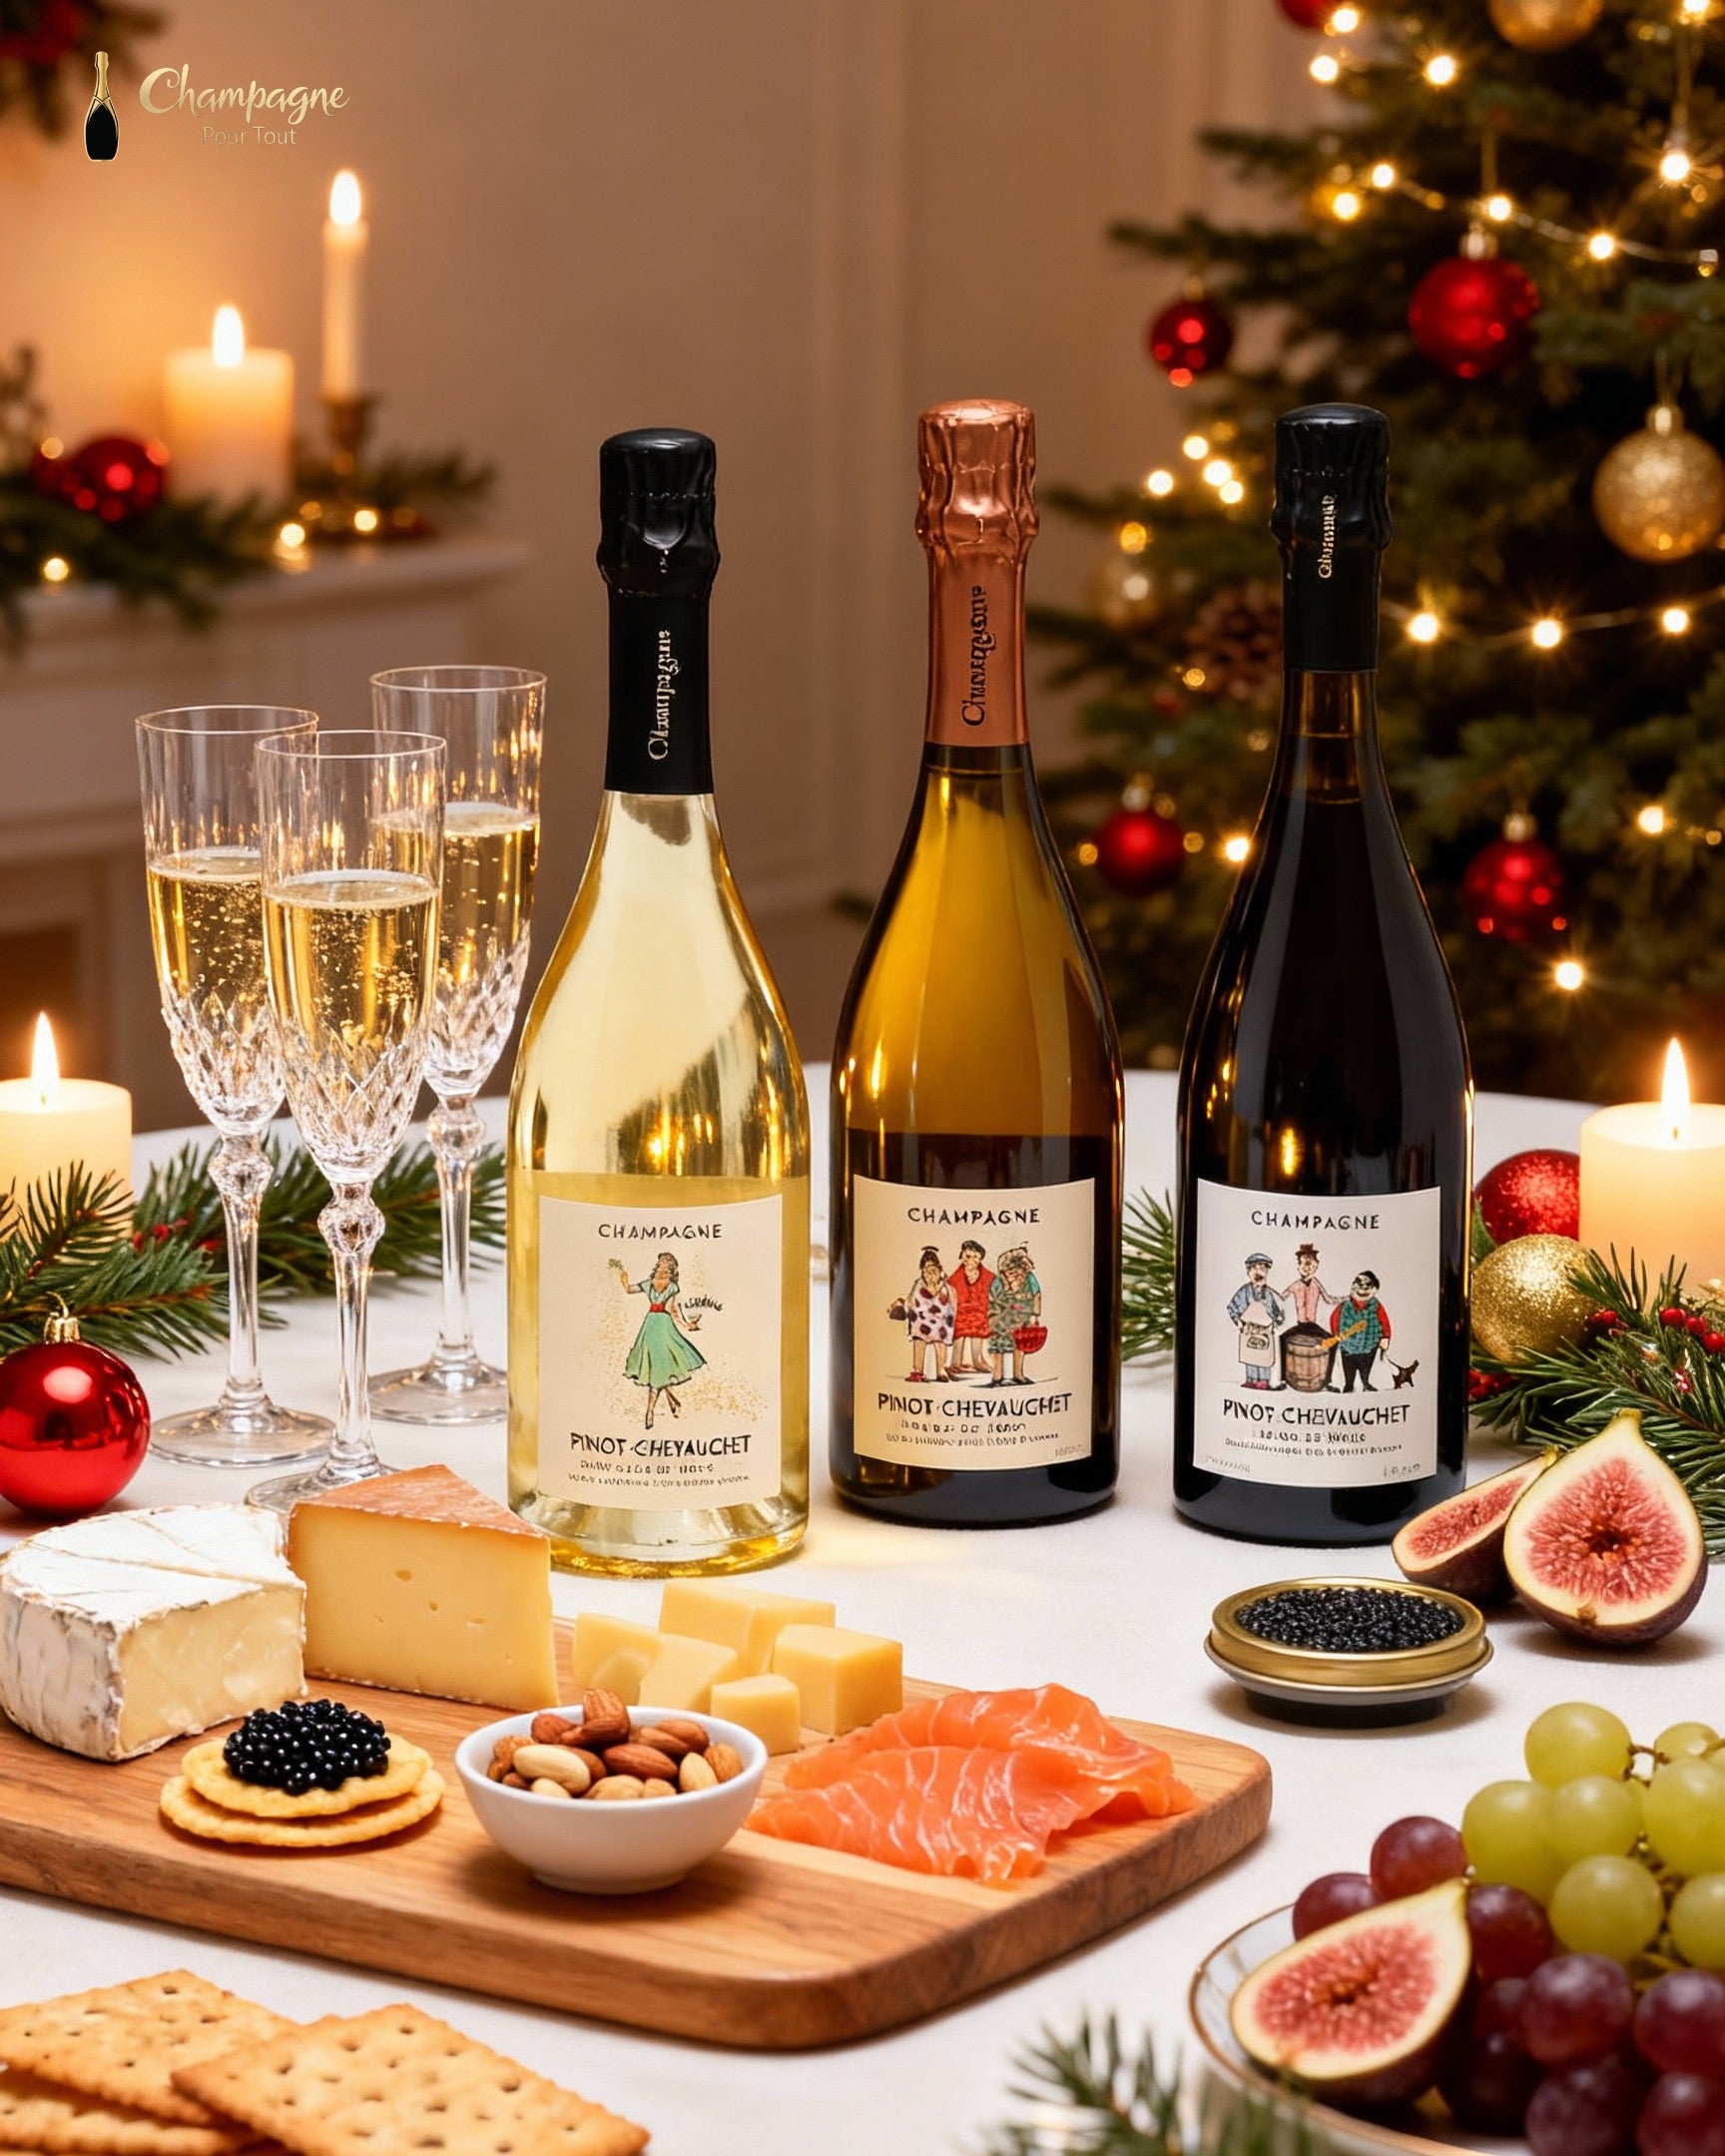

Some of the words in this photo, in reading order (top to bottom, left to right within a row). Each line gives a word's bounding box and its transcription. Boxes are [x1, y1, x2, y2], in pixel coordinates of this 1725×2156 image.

[907, 1207, 1041, 1226] CHAMPAGNE
[1251, 1211, 1381, 1230] CHAMPAGNE
[598, 1224, 723, 1240] CHAMPAGNE
